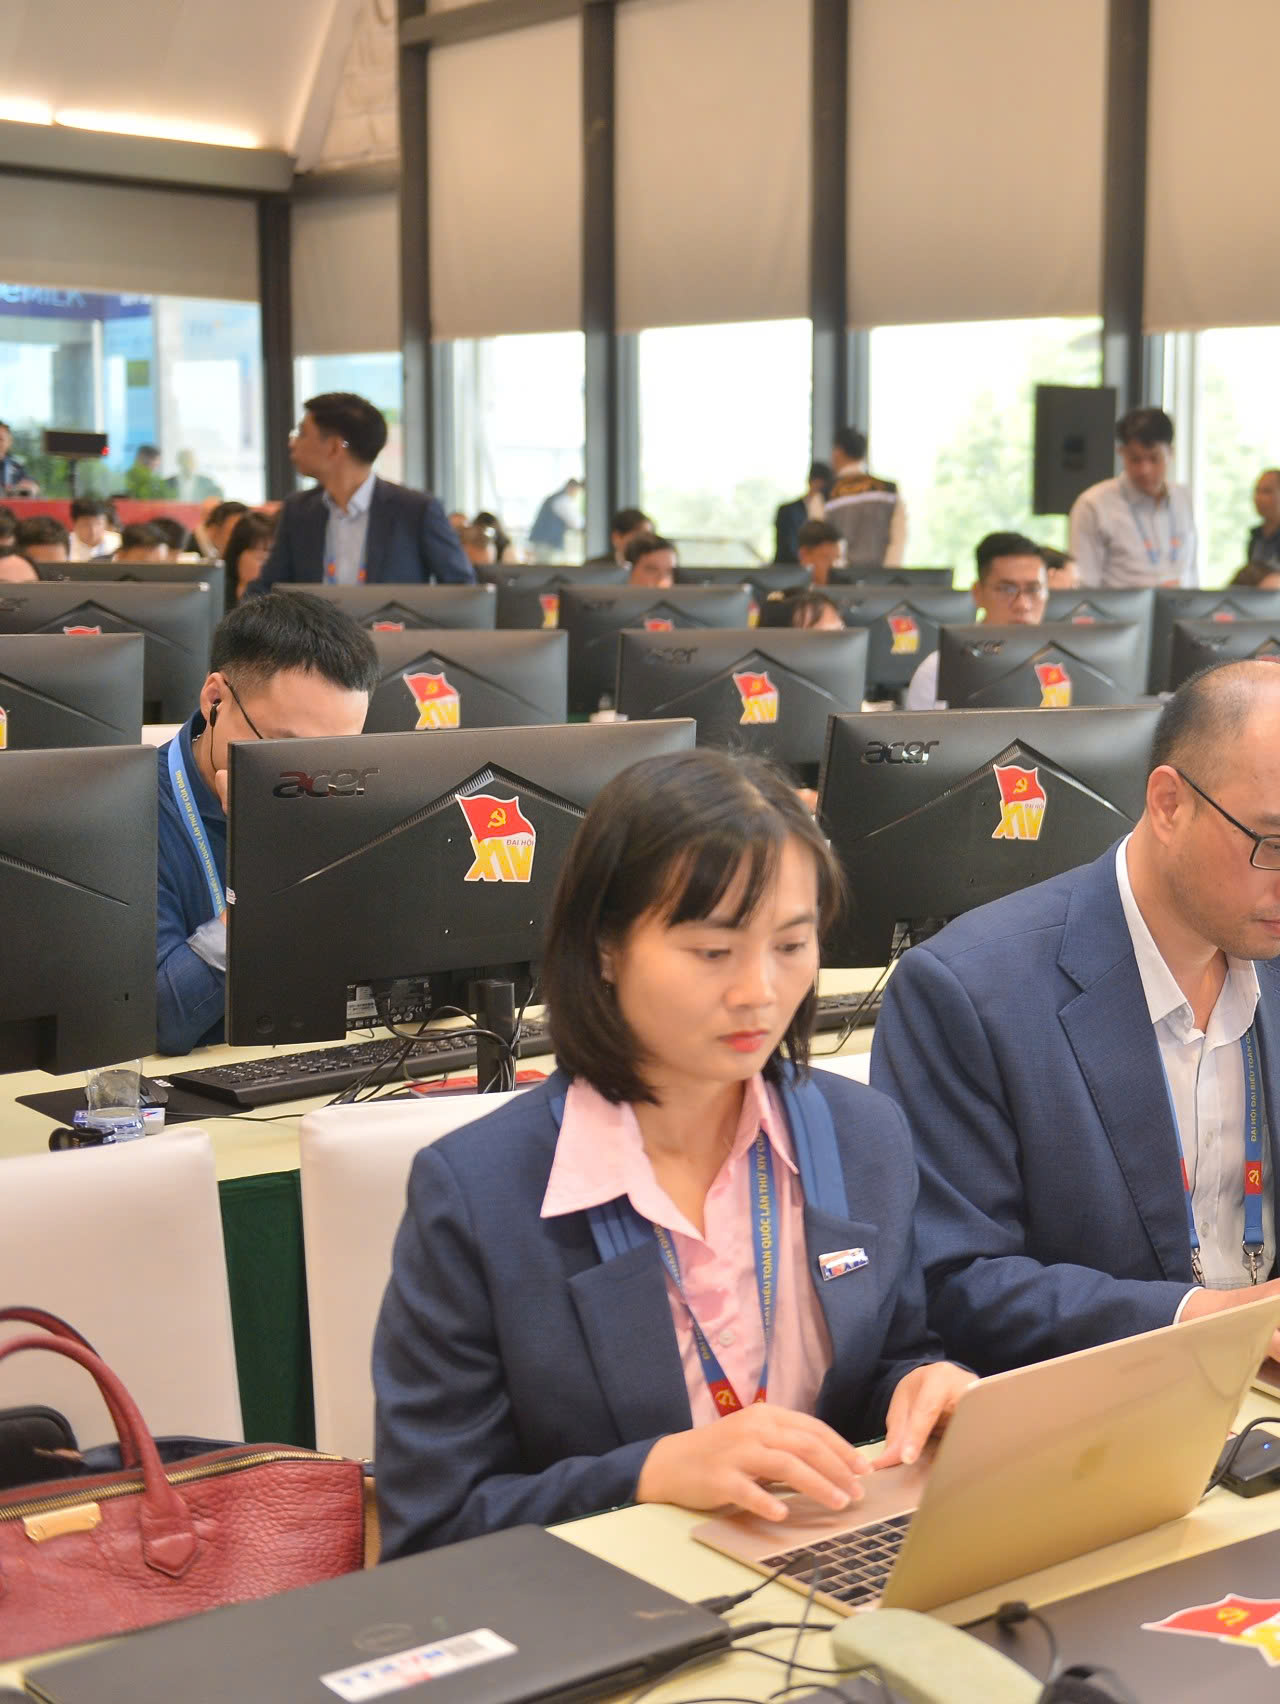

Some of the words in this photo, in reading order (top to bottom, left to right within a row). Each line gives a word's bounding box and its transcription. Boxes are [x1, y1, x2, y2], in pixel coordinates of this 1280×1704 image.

[861, 740, 939, 765] acer
[273, 767, 380, 798] acer
[992, 801, 1045, 839] XIV
[464, 838, 535, 881] XIV
[1246, 1045, 1254, 1068] TOÀN
[757, 1195, 770, 1216] LẦN
[758, 1217, 772, 1249] QUỐC
[760, 1250, 774, 1279] TOÀN
